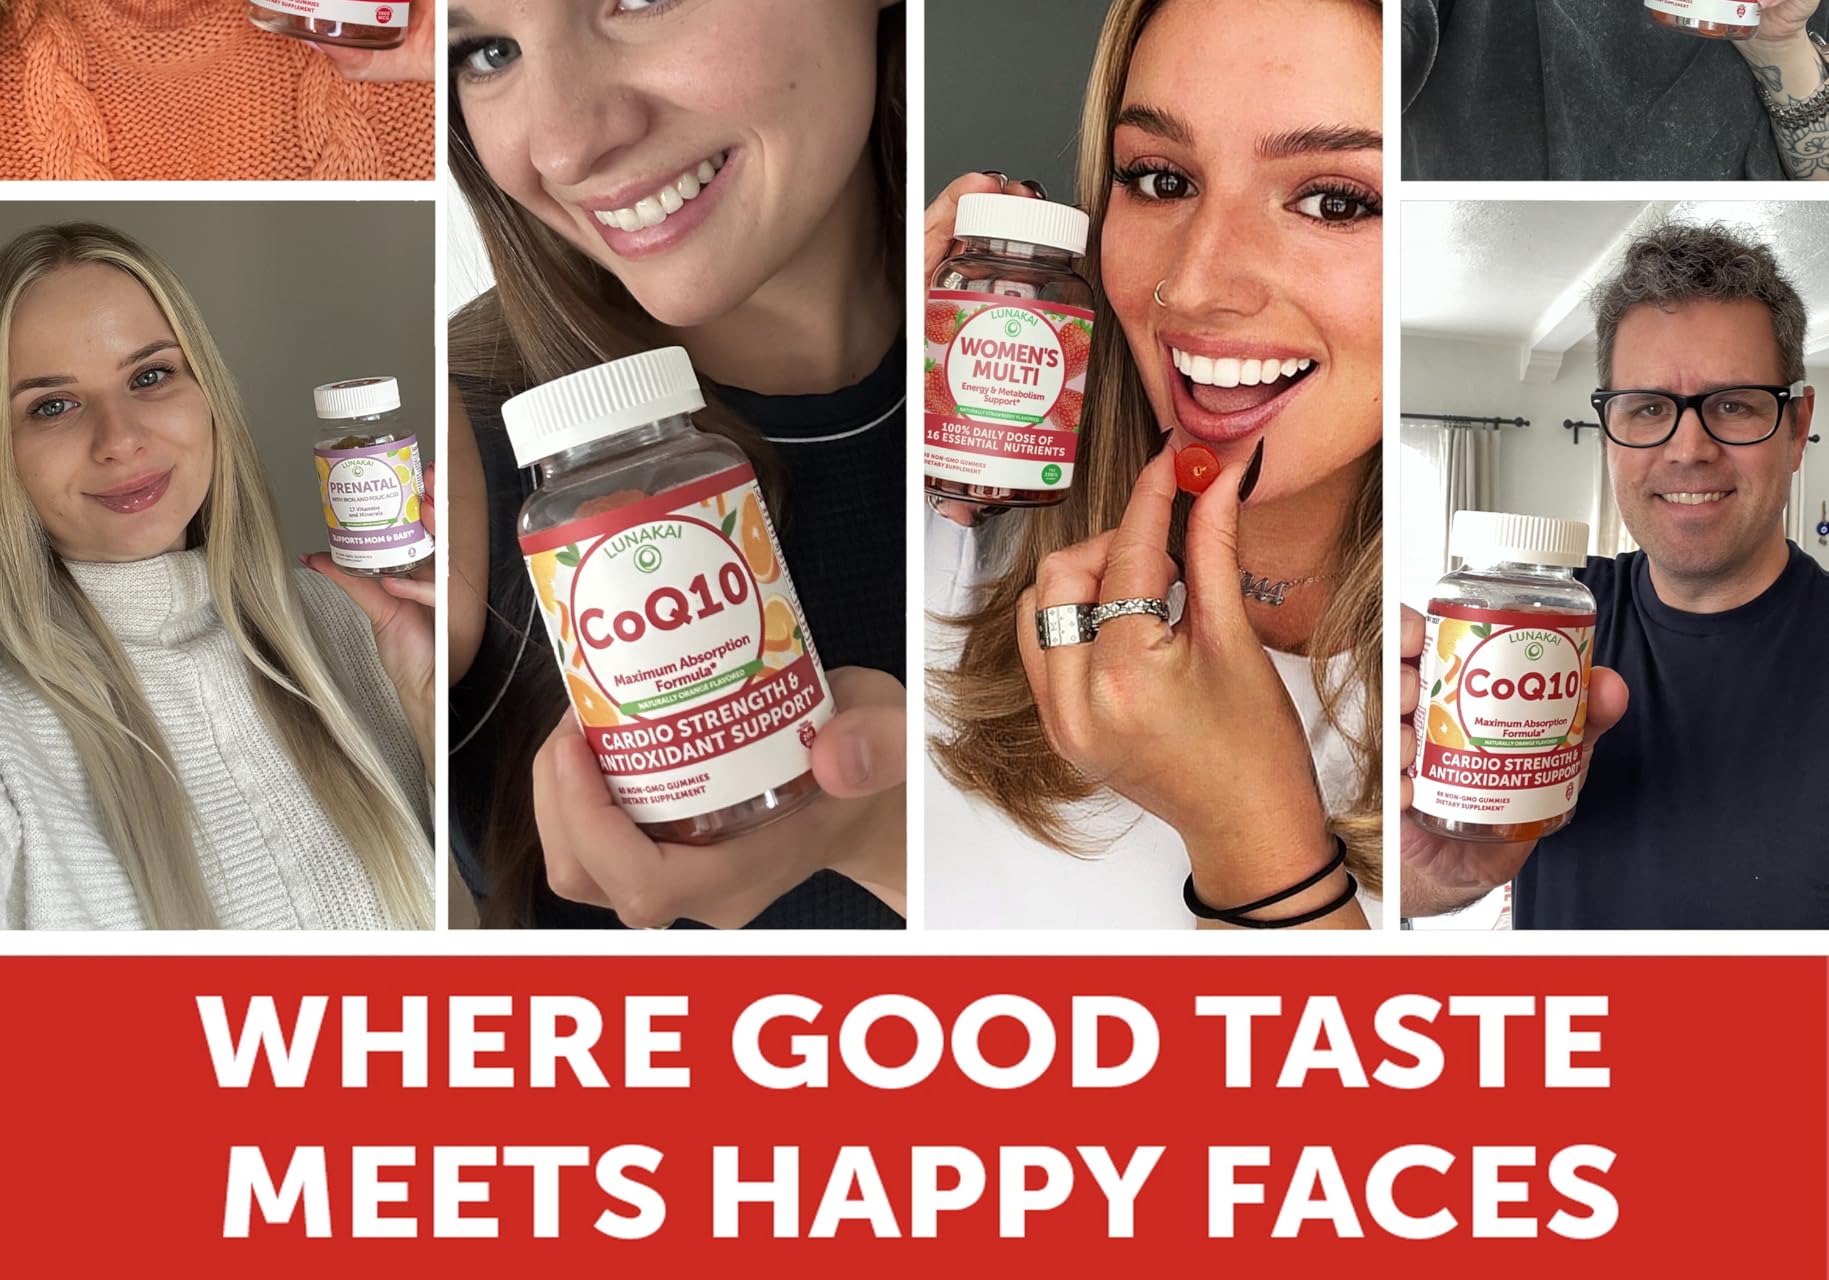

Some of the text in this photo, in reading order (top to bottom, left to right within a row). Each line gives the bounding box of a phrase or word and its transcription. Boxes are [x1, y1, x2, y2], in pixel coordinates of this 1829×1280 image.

[281, 1, 315, 13] SUPPLEMENT
[991, 308, 1039, 326] LUNAKAI
[960, 337, 1059, 368] WOMEN'S
[972, 360, 1040, 386] MULTI
[961, 382, 1045, 400] Energy & Metabolism
[927, 430, 1066, 456] 16 ESSENTIAL NUTRIENTS
[942, 422, 1054, 445] 100% DAILY DOSE OF
[341, 460, 374, 469] LUNAKAI
[330, 477, 397, 494] PRENATAL
[603, 524, 682, 559] LUNAKAI
[579, 562, 748, 649] CoQ10
[1509, 631, 1562, 646] LUNAKAI
[613, 634, 751, 686] Maximum Absorption
[638, 668, 746, 710] NATURALLY ORANGE FLAVORED
[1464, 668, 1579, 702] CoQ10
[602, 671, 799, 751] CARDIO STRENGTH &
[1474, 717, 1567, 728] Maximum Absorption
[600, 730, 726, 772] ANTIOXIDANT
[1442, 751, 1578, 771] CARDIO STRENGTH &
[627, 773, 710, 794] NON-GMO GUMMIES
[1429, 765, 1532, 787] ANTIOXIDANT
[621, 785, 706, 805] DIETARY SUPPLEMENT
[1436, 798, 1504, 812] DIETARY SUPPLEMENT
[1445, 792, 1477, 803] NON-GMO
